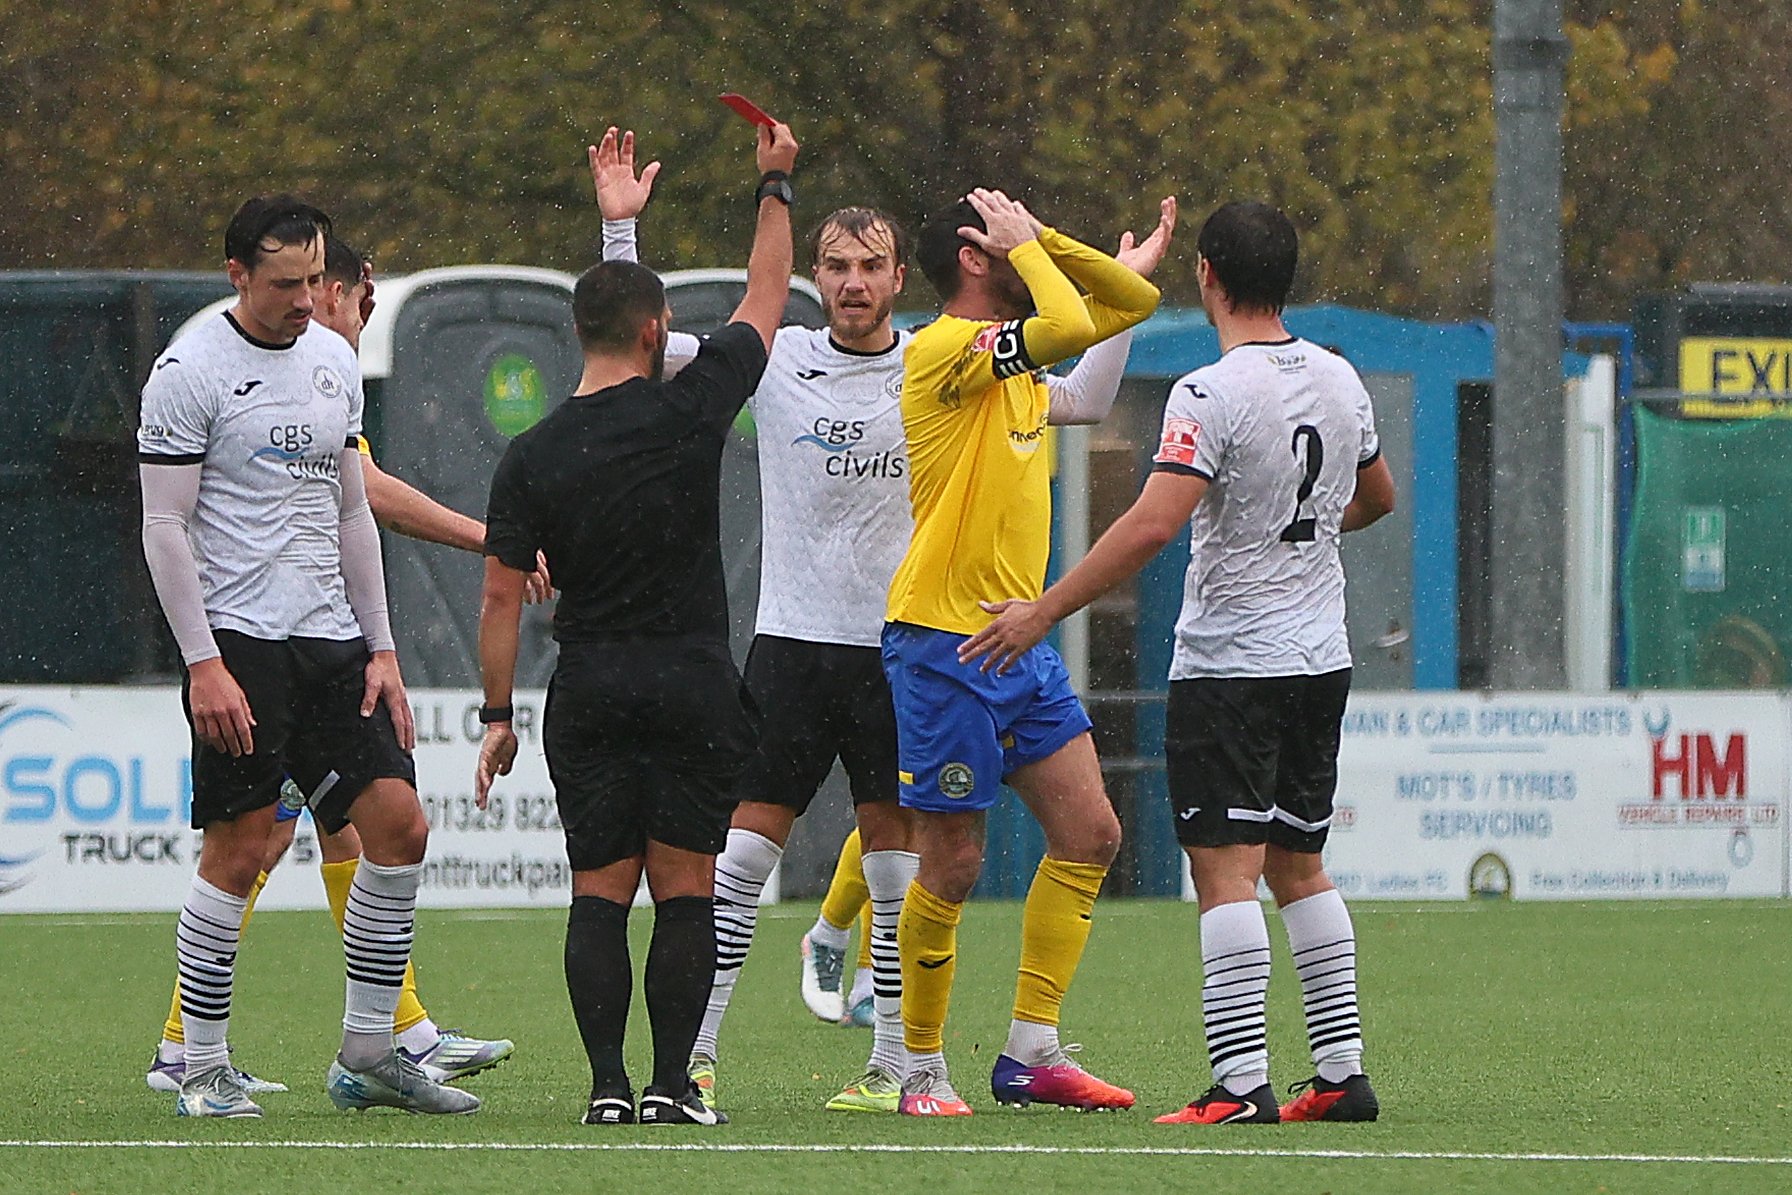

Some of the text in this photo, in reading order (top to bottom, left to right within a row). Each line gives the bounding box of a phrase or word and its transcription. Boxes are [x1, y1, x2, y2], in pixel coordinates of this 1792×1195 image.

[269, 424, 313, 453] cgs
[814, 416, 865, 445] cgs
[286, 452, 340, 480] civils
[825, 450, 904, 479] civils
[1280, 424, 1324, 542] 2
[1478, 708, 1632, 735] SPECIALISTS
[1652, 734, 1747, 800] HM
[1498, 772, 1577, 800] TYRES
[1420, 810, 1551, 838] SERVICING
[61, 834, 181, 863] TRUCK
